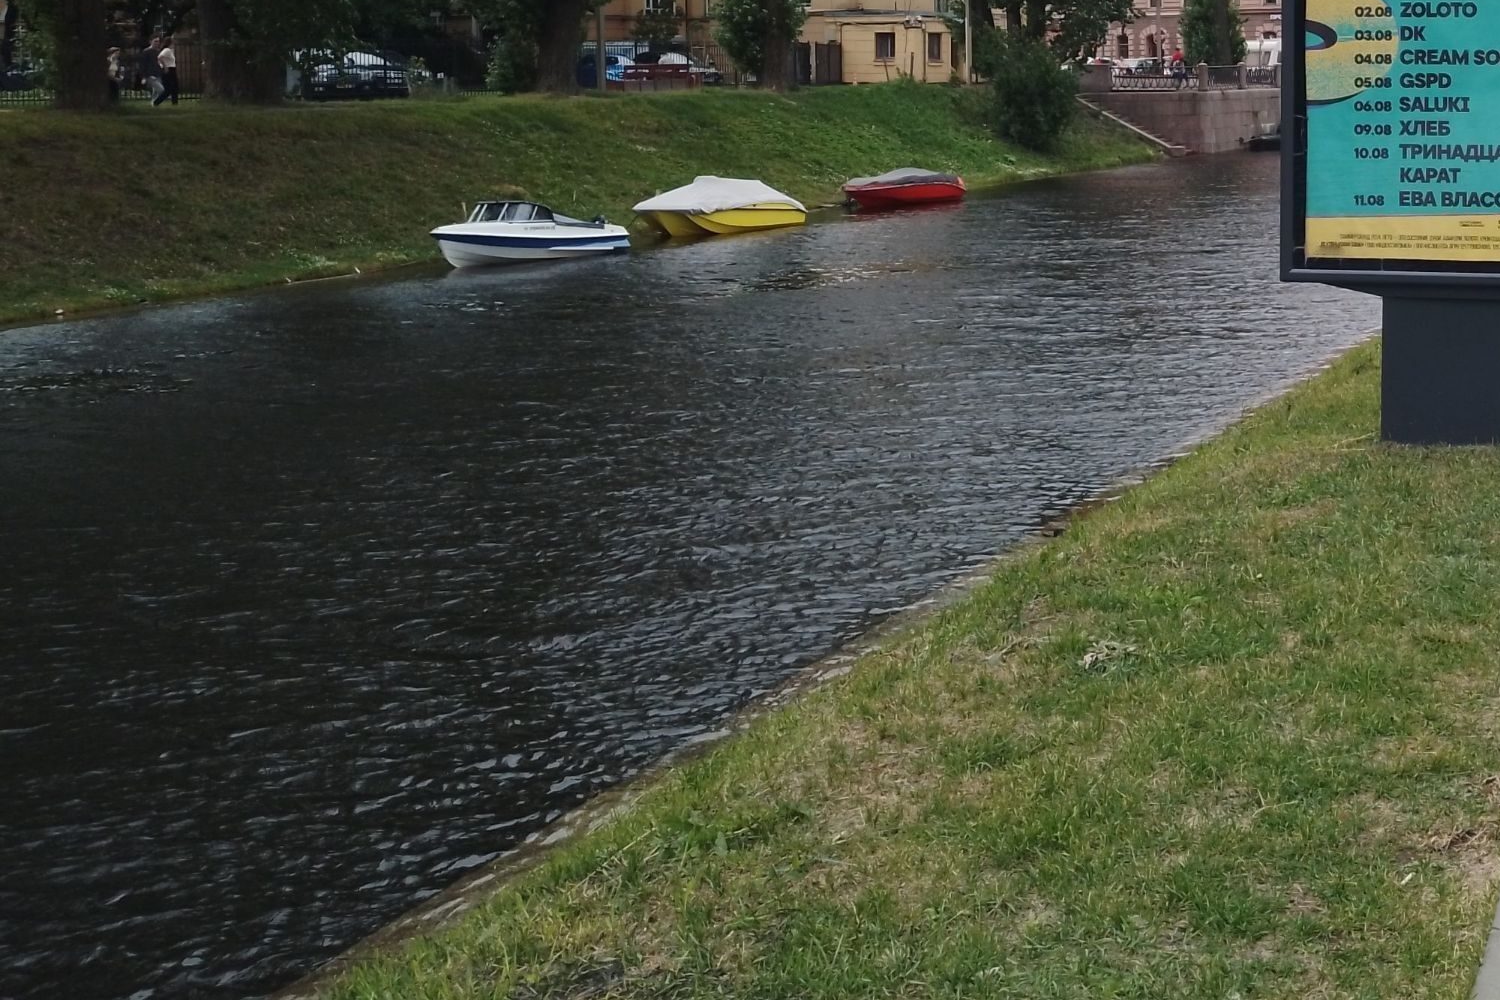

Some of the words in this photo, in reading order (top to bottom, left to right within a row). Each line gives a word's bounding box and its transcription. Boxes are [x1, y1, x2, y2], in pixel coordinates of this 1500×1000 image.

[1354, 5, 1393, 18] 02.08
[1399, 1, 1478, 18] ZOLOTO
[1354, 29, 1393, 42] 03.08
[1400, 25, 1426, 42] DK
[1354, 53, 1393, 65] 04.08
[1399, 48, 1470, 66] CREAM
[1354, 76, 1393, 89] 05.08
[1399, 72, 1452, 89] GSPD
[1353, 100, 1393, 112] 06.08
[1399, 96, 1470, 113] SALUKI
[1353, 123, 1392, 136] 09.08
[1399, 120, 1451, 137] ХЛЕБ
[1353, 147, 1389, 159] 10.08
[1399, 167, 1462, 184] КАРАТ
[1353, 194, 1385, 207] 11.08
[1398, 190, 1437, 207] ЕВА
